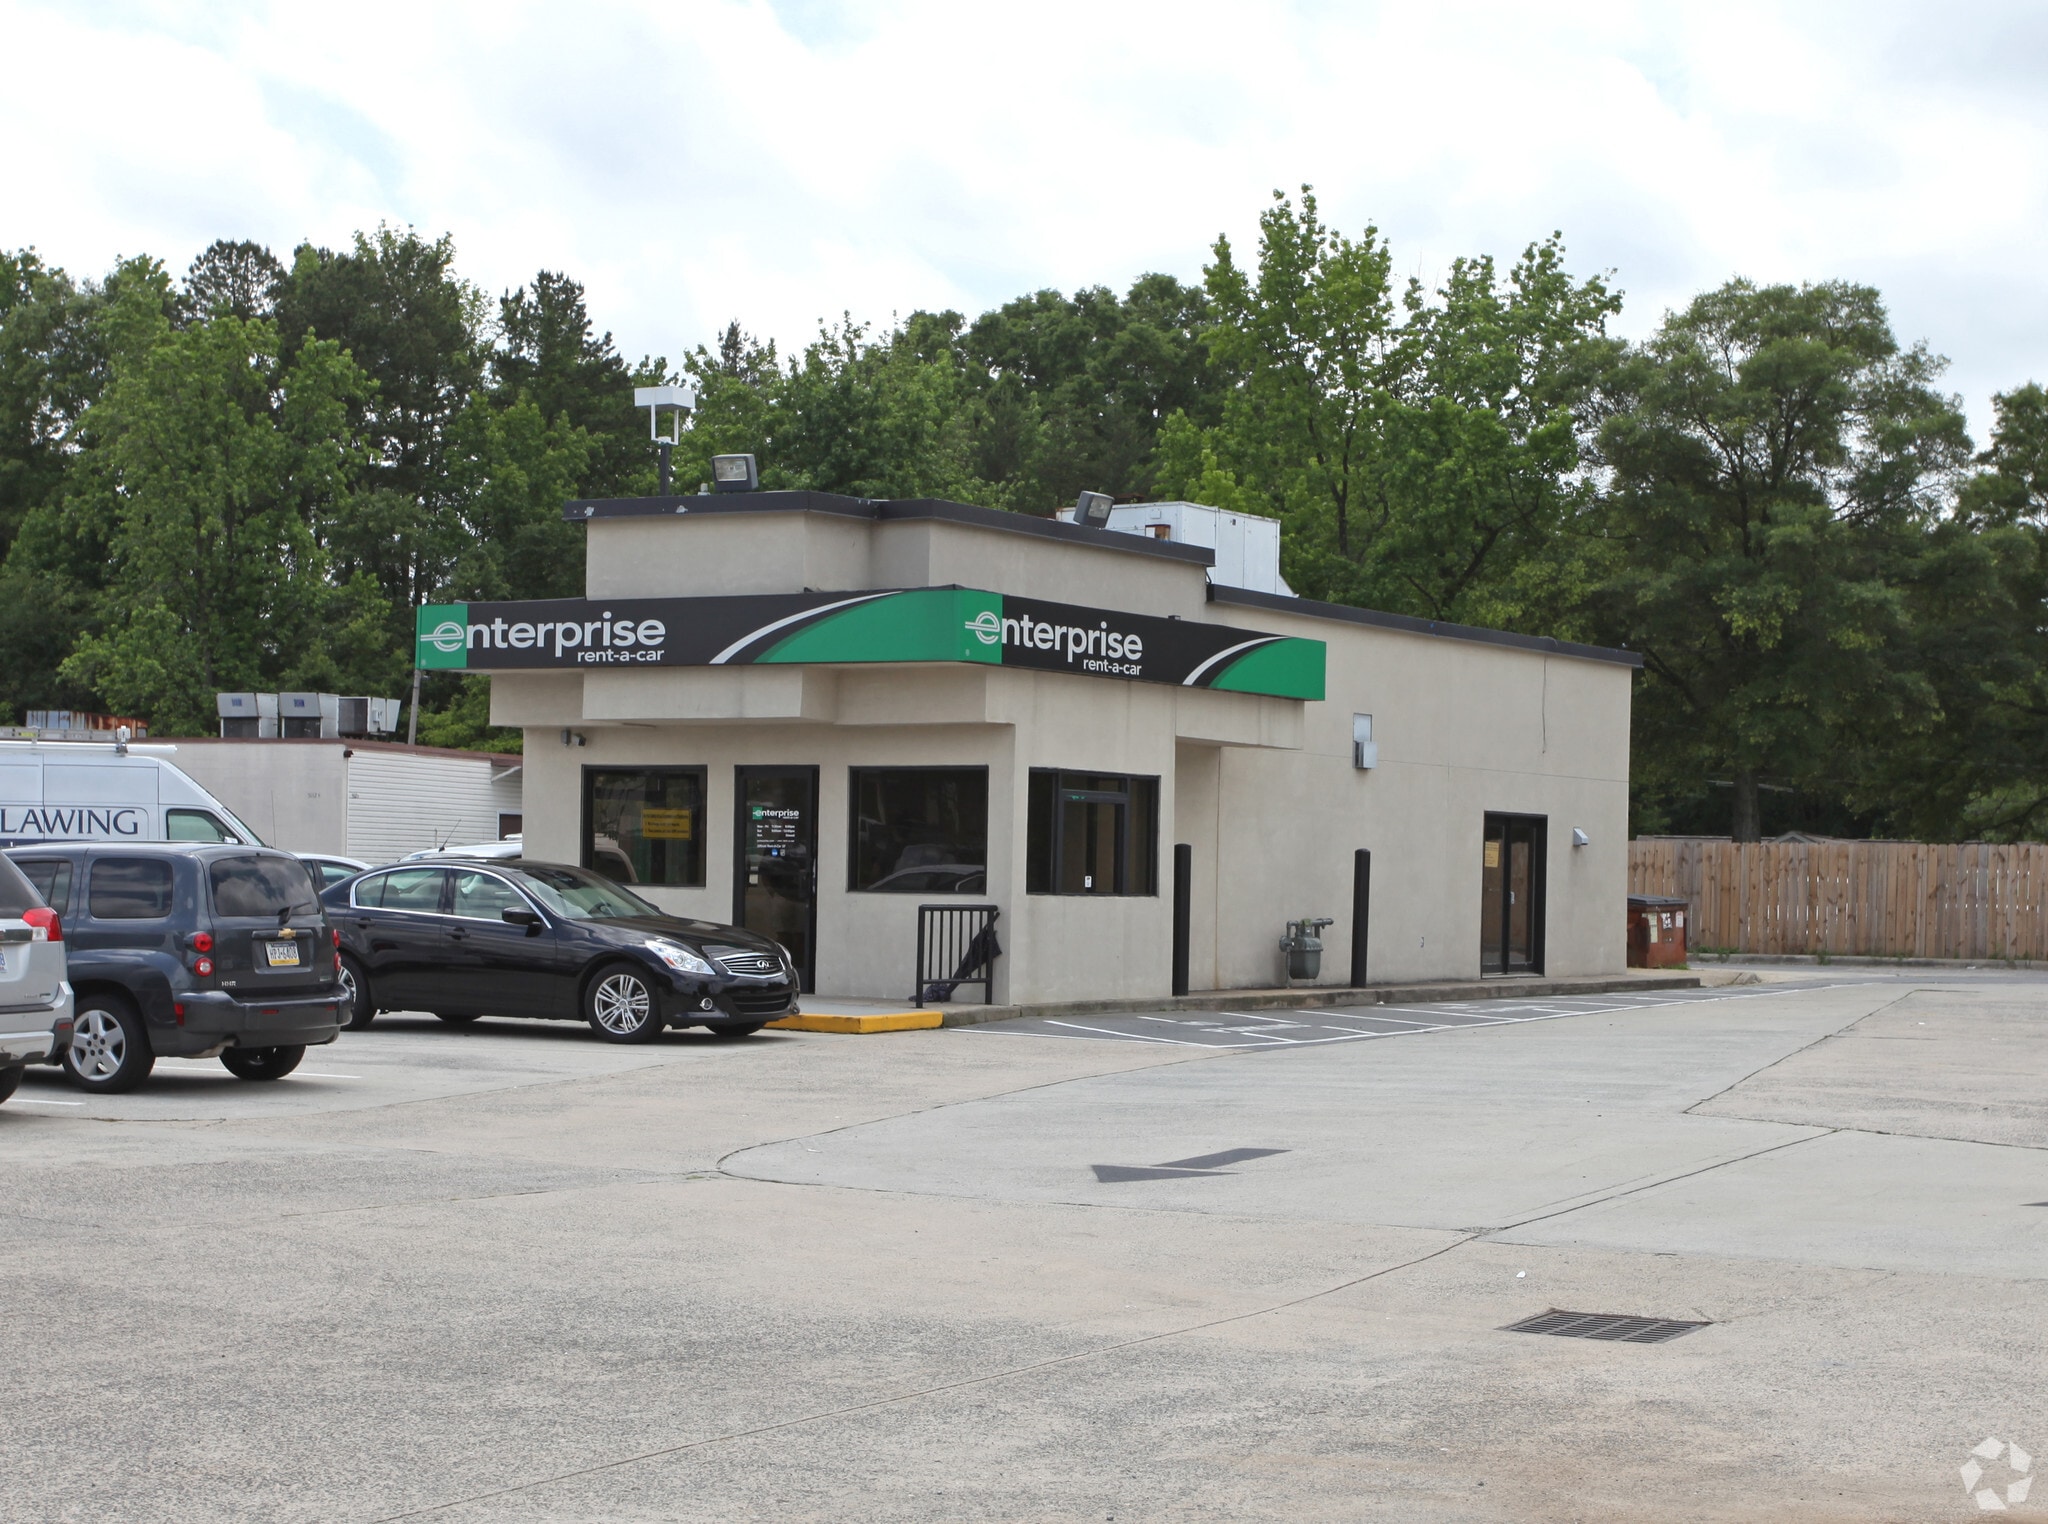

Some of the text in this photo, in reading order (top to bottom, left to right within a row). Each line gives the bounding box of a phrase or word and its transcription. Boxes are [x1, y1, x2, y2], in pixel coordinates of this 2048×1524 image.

[420, 610, 666, 658] enterprise
[965, 611, 1143, 663] enterprise
[577, 649, 665, 662] rent-a-car
[1083, 659, 1142, 676] rent-a-car
[0, 808, 139, 835] LAWING
[752, 808, 800, 819] enterprise
